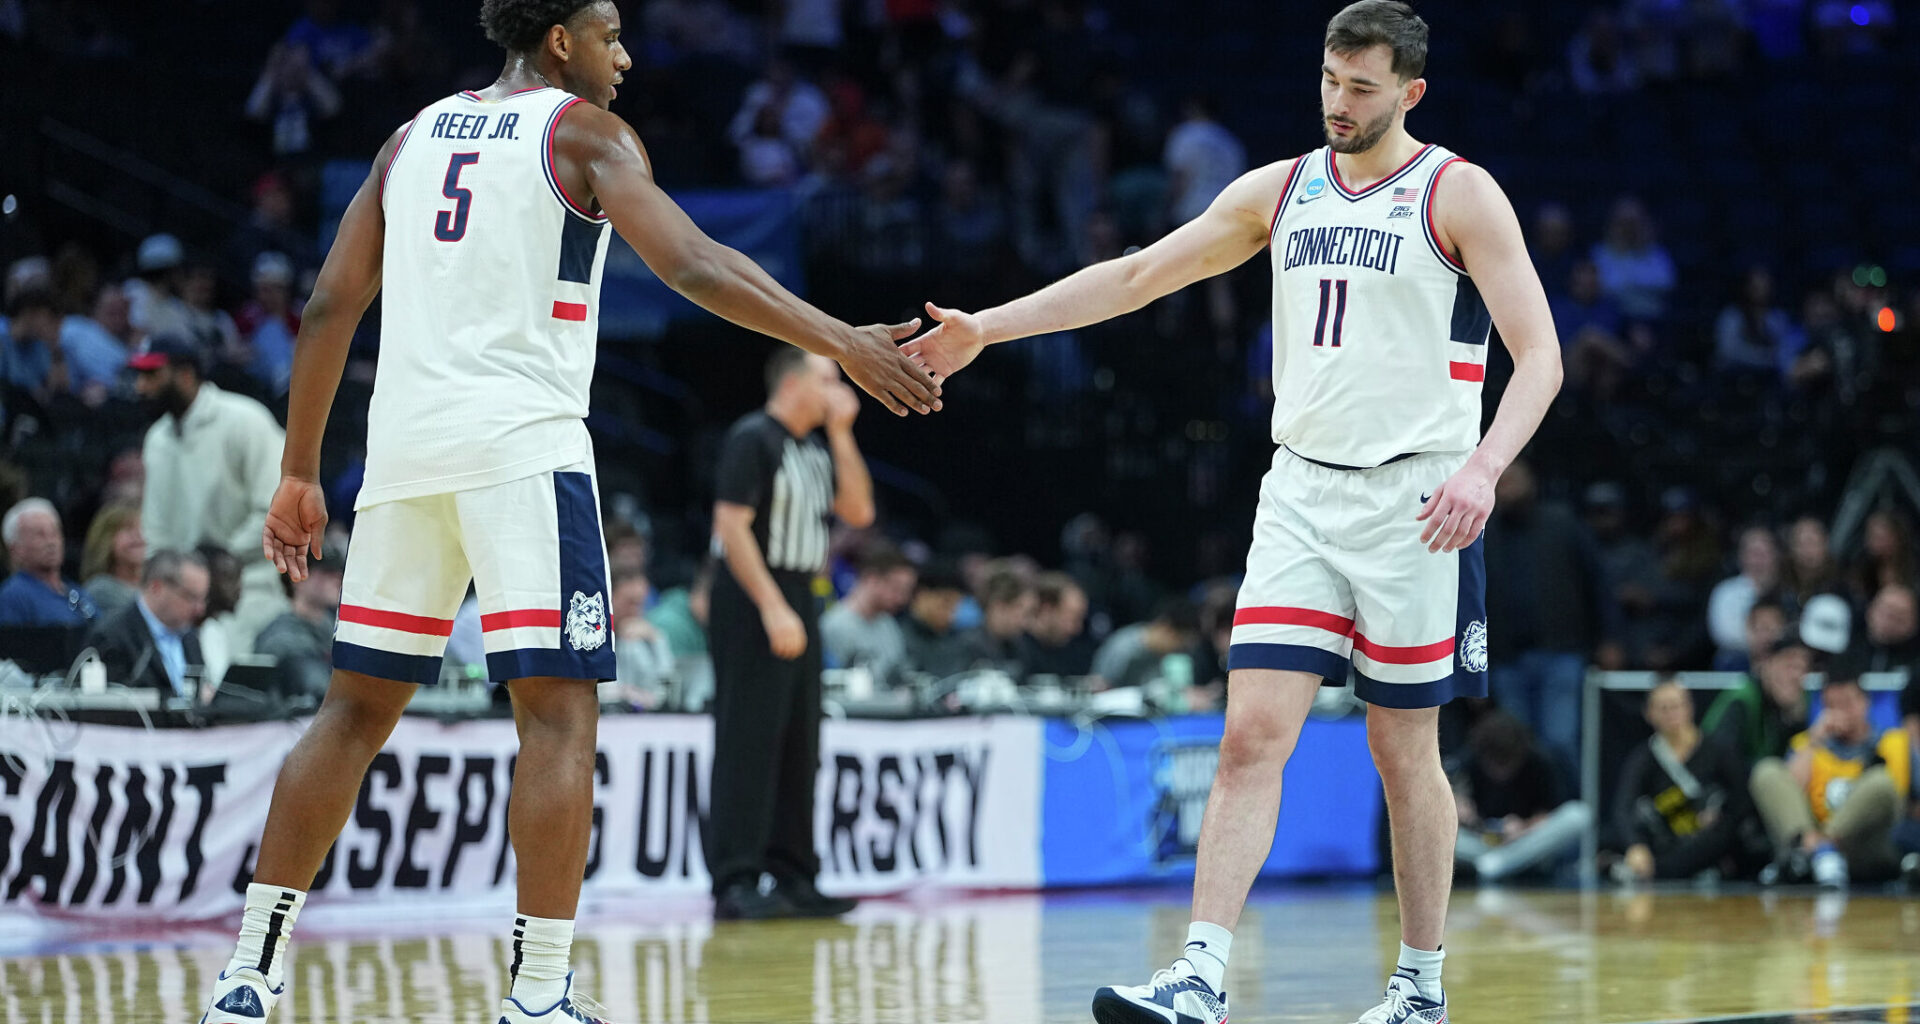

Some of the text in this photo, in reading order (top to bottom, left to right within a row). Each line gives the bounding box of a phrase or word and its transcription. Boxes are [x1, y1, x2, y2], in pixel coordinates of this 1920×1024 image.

[431, 112, 520, 140] REED JR.
[434, 151, 480, 243] 5
[1284, 226, 1405, 275] CONNECTICUT
[1313, 279, 1348, 347] 11
